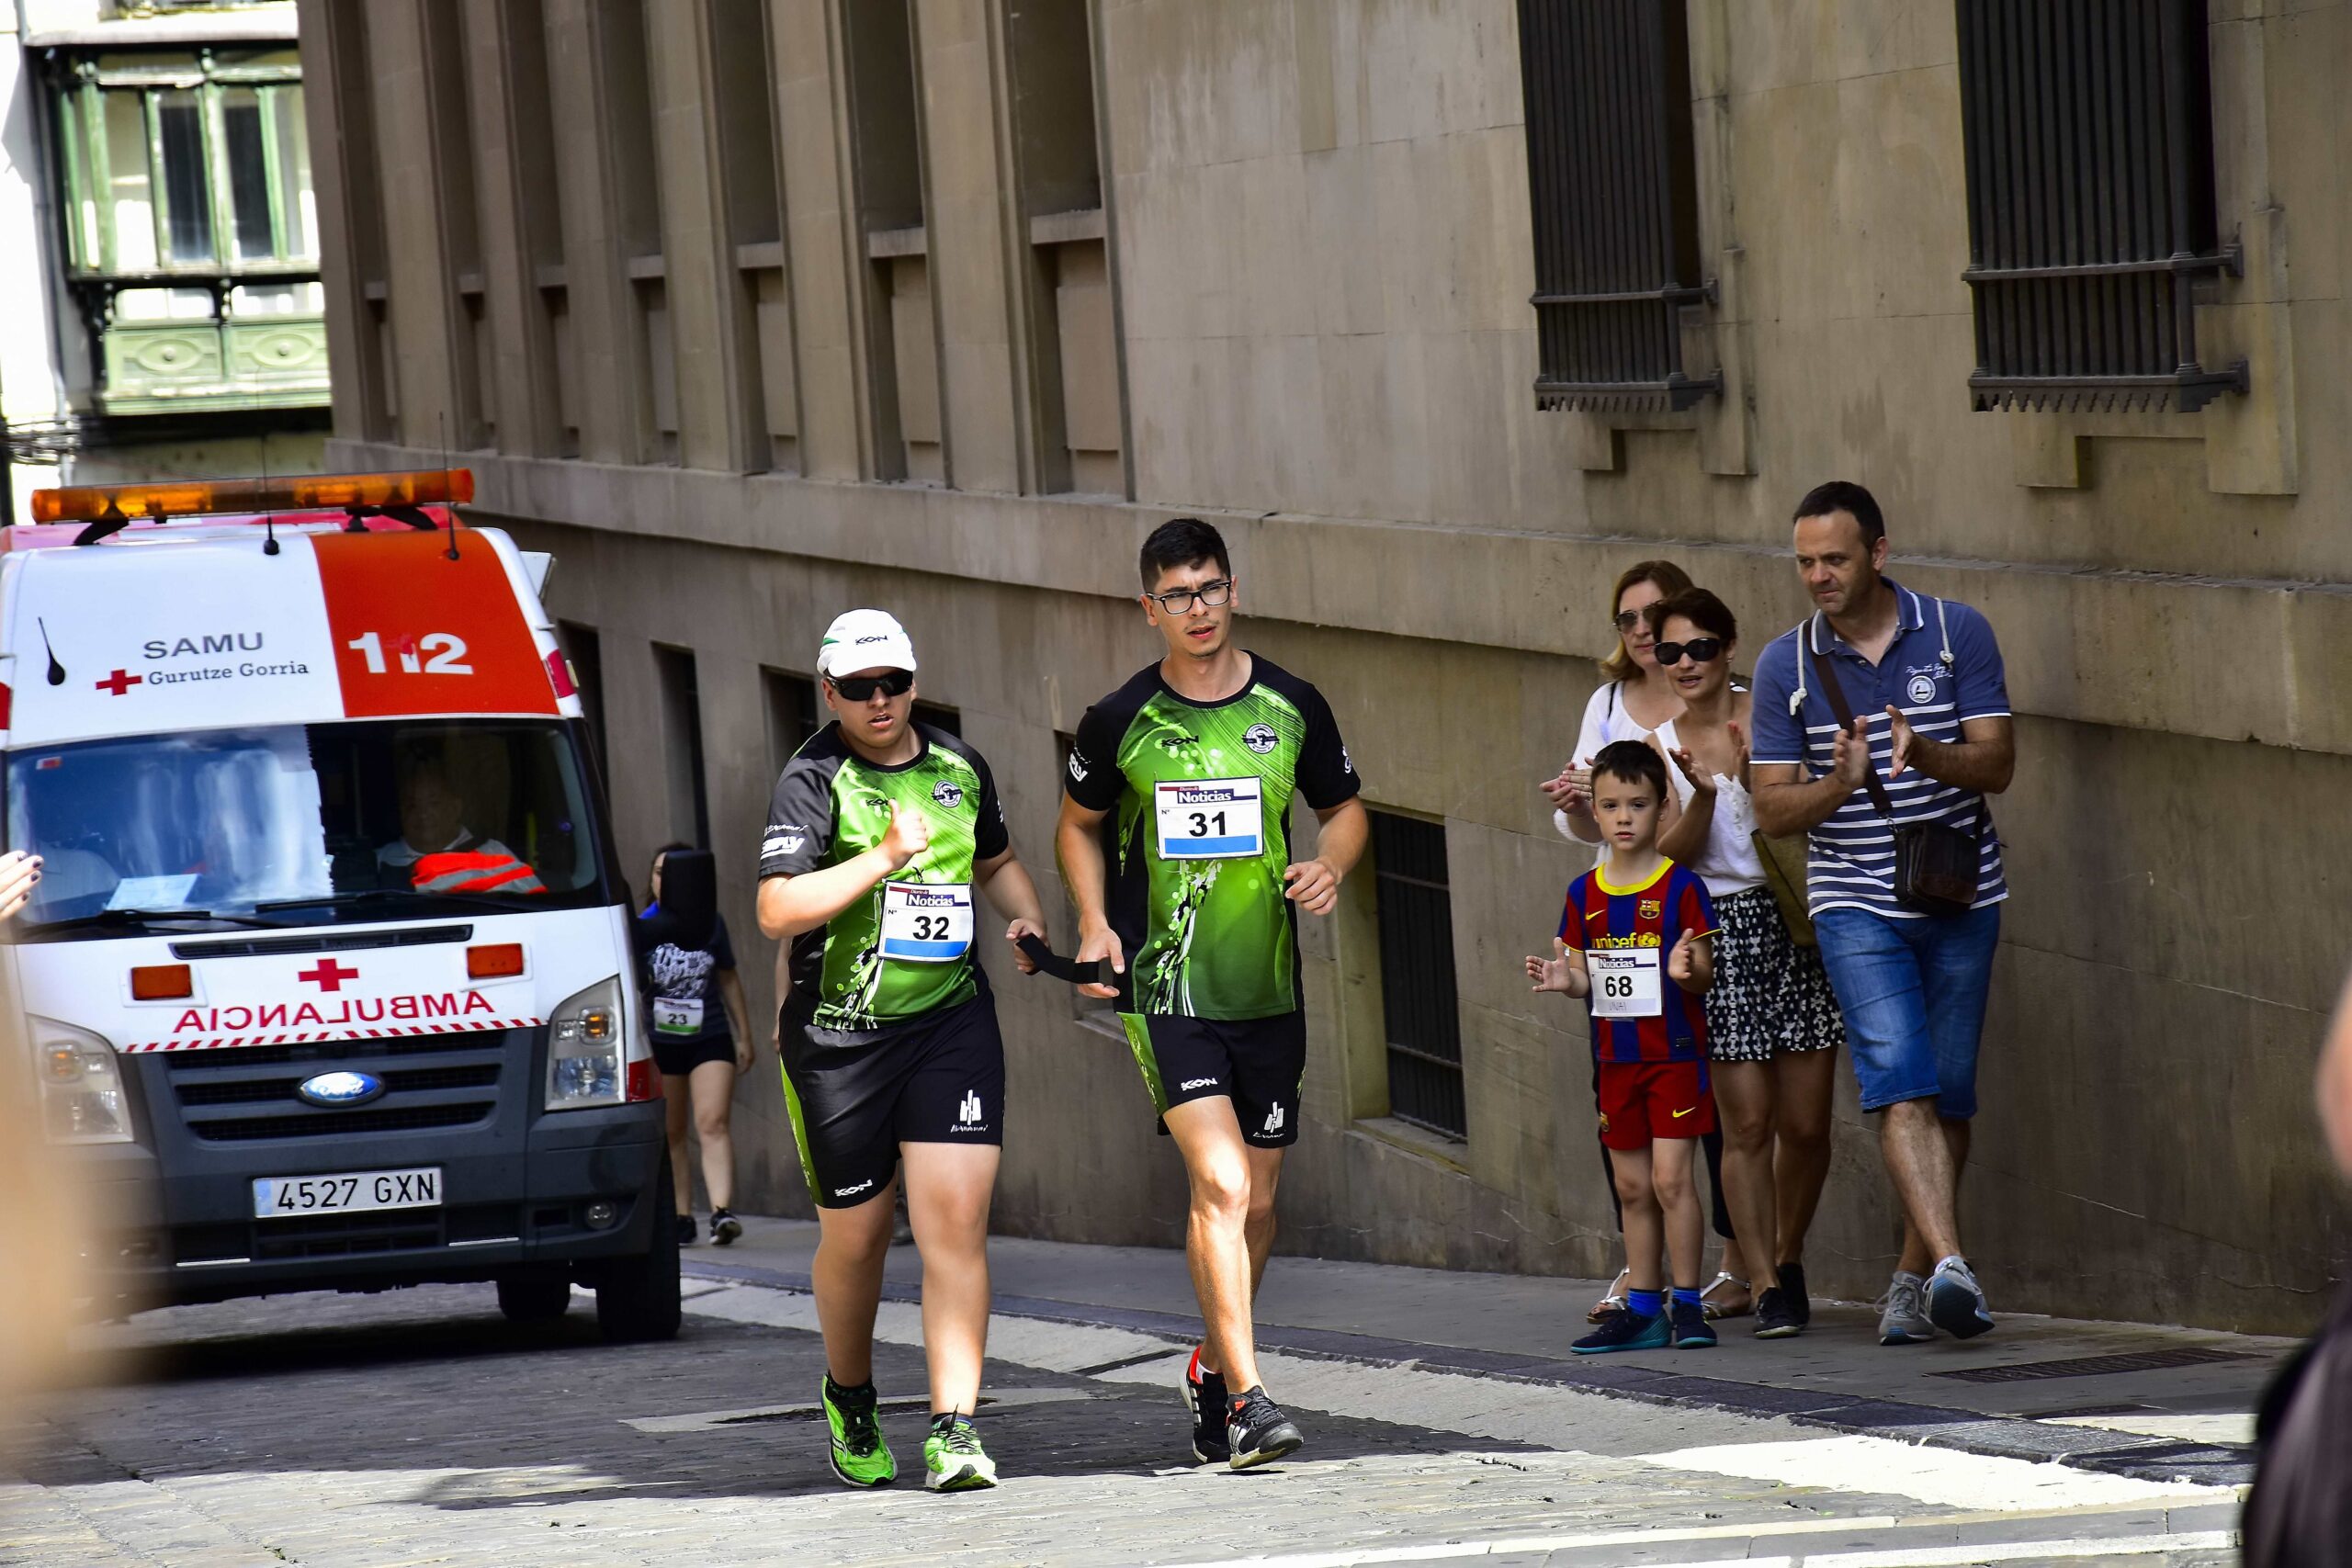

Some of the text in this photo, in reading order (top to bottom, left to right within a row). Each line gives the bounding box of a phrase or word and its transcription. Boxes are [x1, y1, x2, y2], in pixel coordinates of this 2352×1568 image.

[143, 632, 263, 660] SAMU
[348, 632, 473, 675] 112
[149, 661, 309, 685] Gurutze Gorria
[1178, 790, 1232, 803] Noticias
[1189, 811, 1227, 838] 31
[908, 894, 955, 907] Noticias
[912, 916, 950, 941] 32
[1592, 932, 1637, 949] unicef
[1605, 976, 1634, 998] 68
[667, 1013, 688, 1025] 23
[277, 1173, 435, 1210] 4527 GXN
